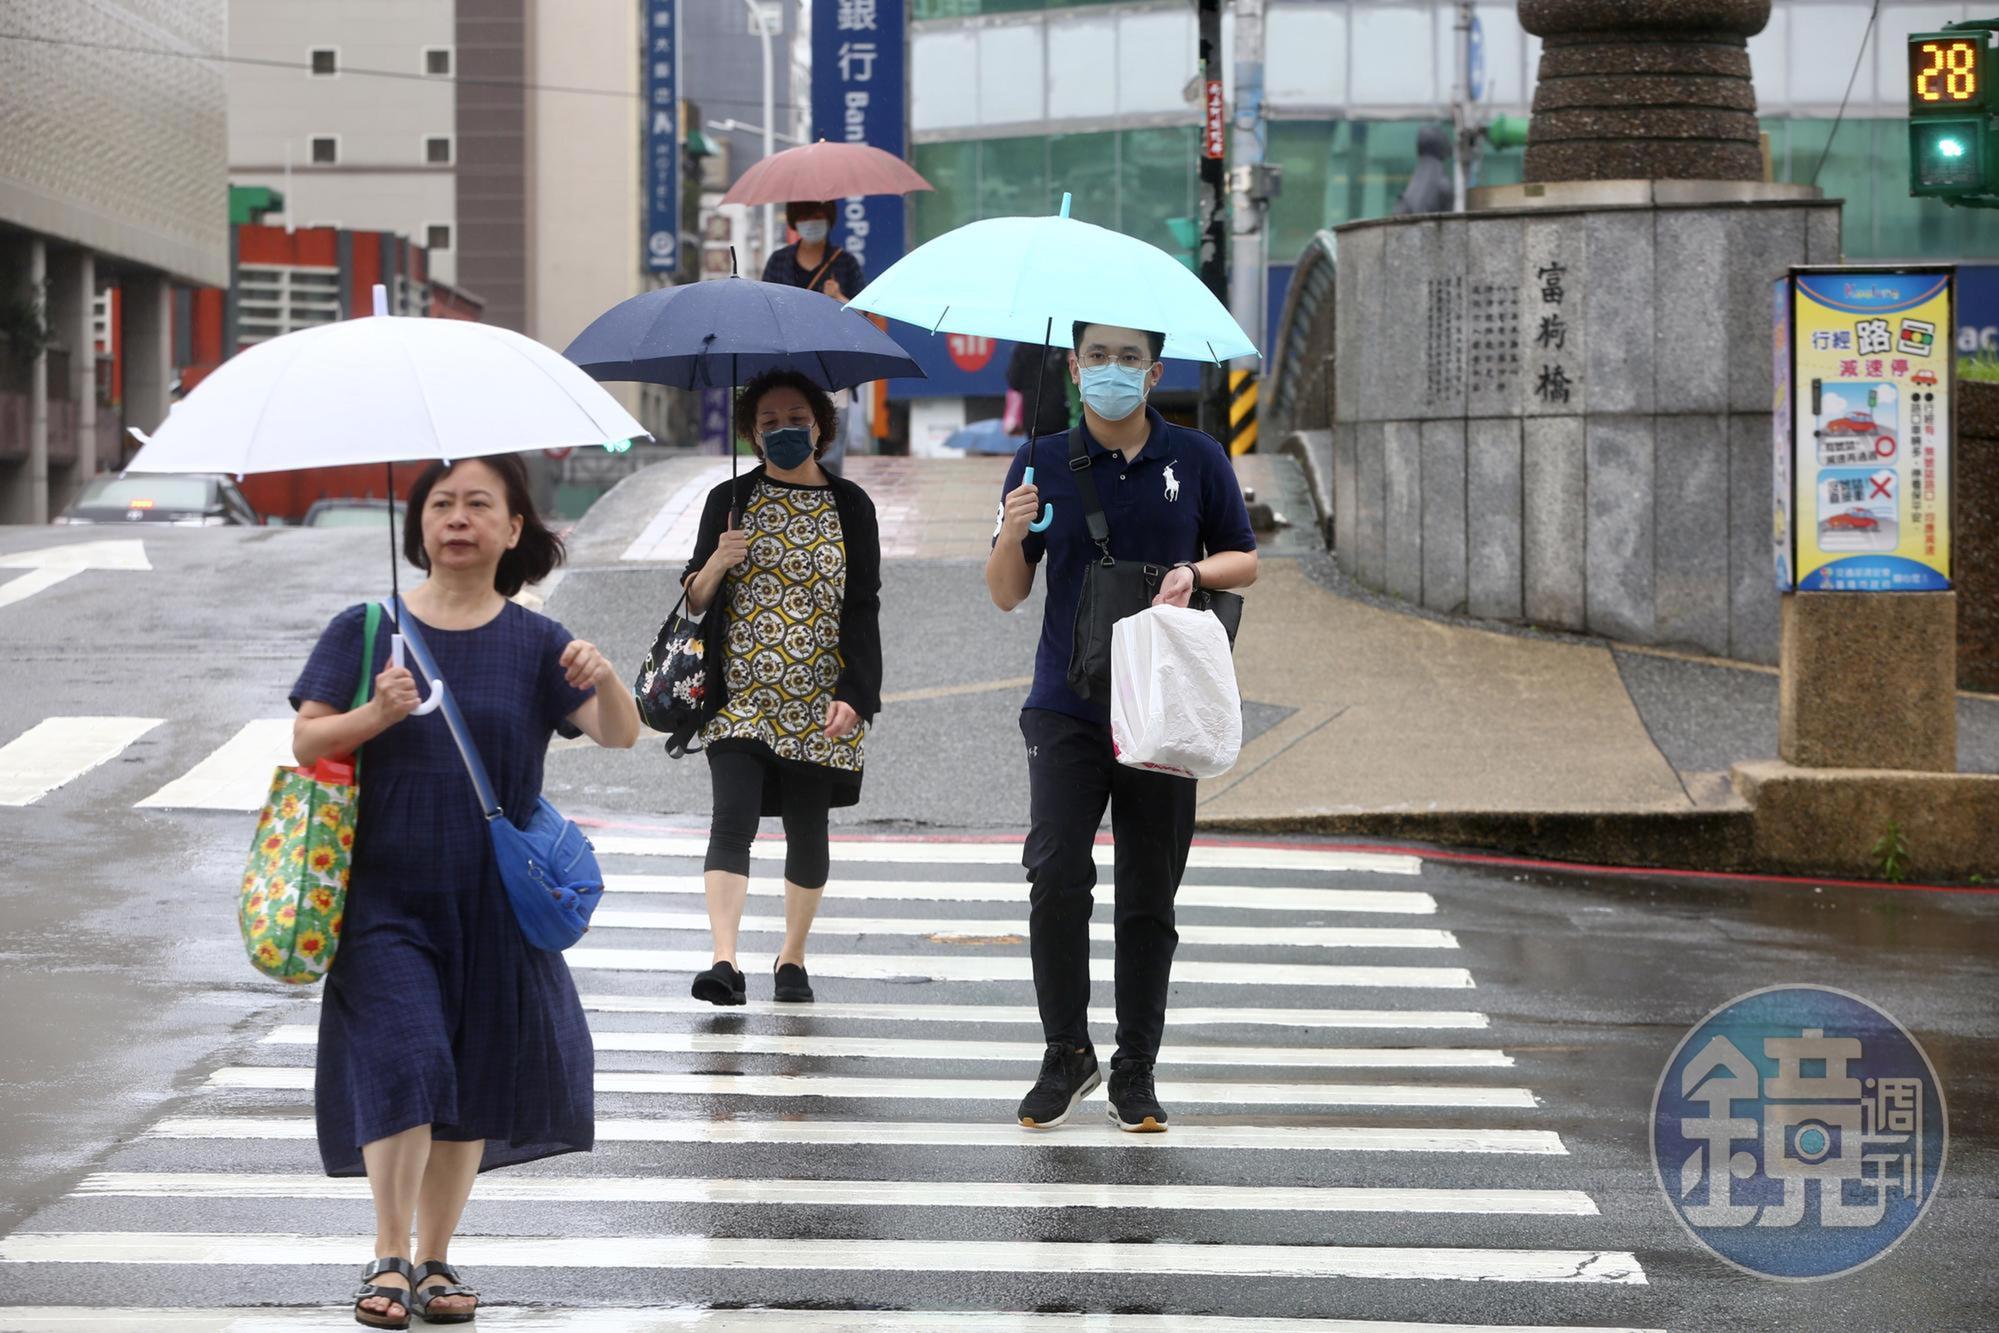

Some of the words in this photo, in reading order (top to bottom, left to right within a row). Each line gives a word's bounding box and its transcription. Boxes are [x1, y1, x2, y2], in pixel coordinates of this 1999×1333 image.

[837, 0, 878, 82] 銀行
[1916, 43, 1976, 101] 28
[843, 91, 870, 148] Ban
